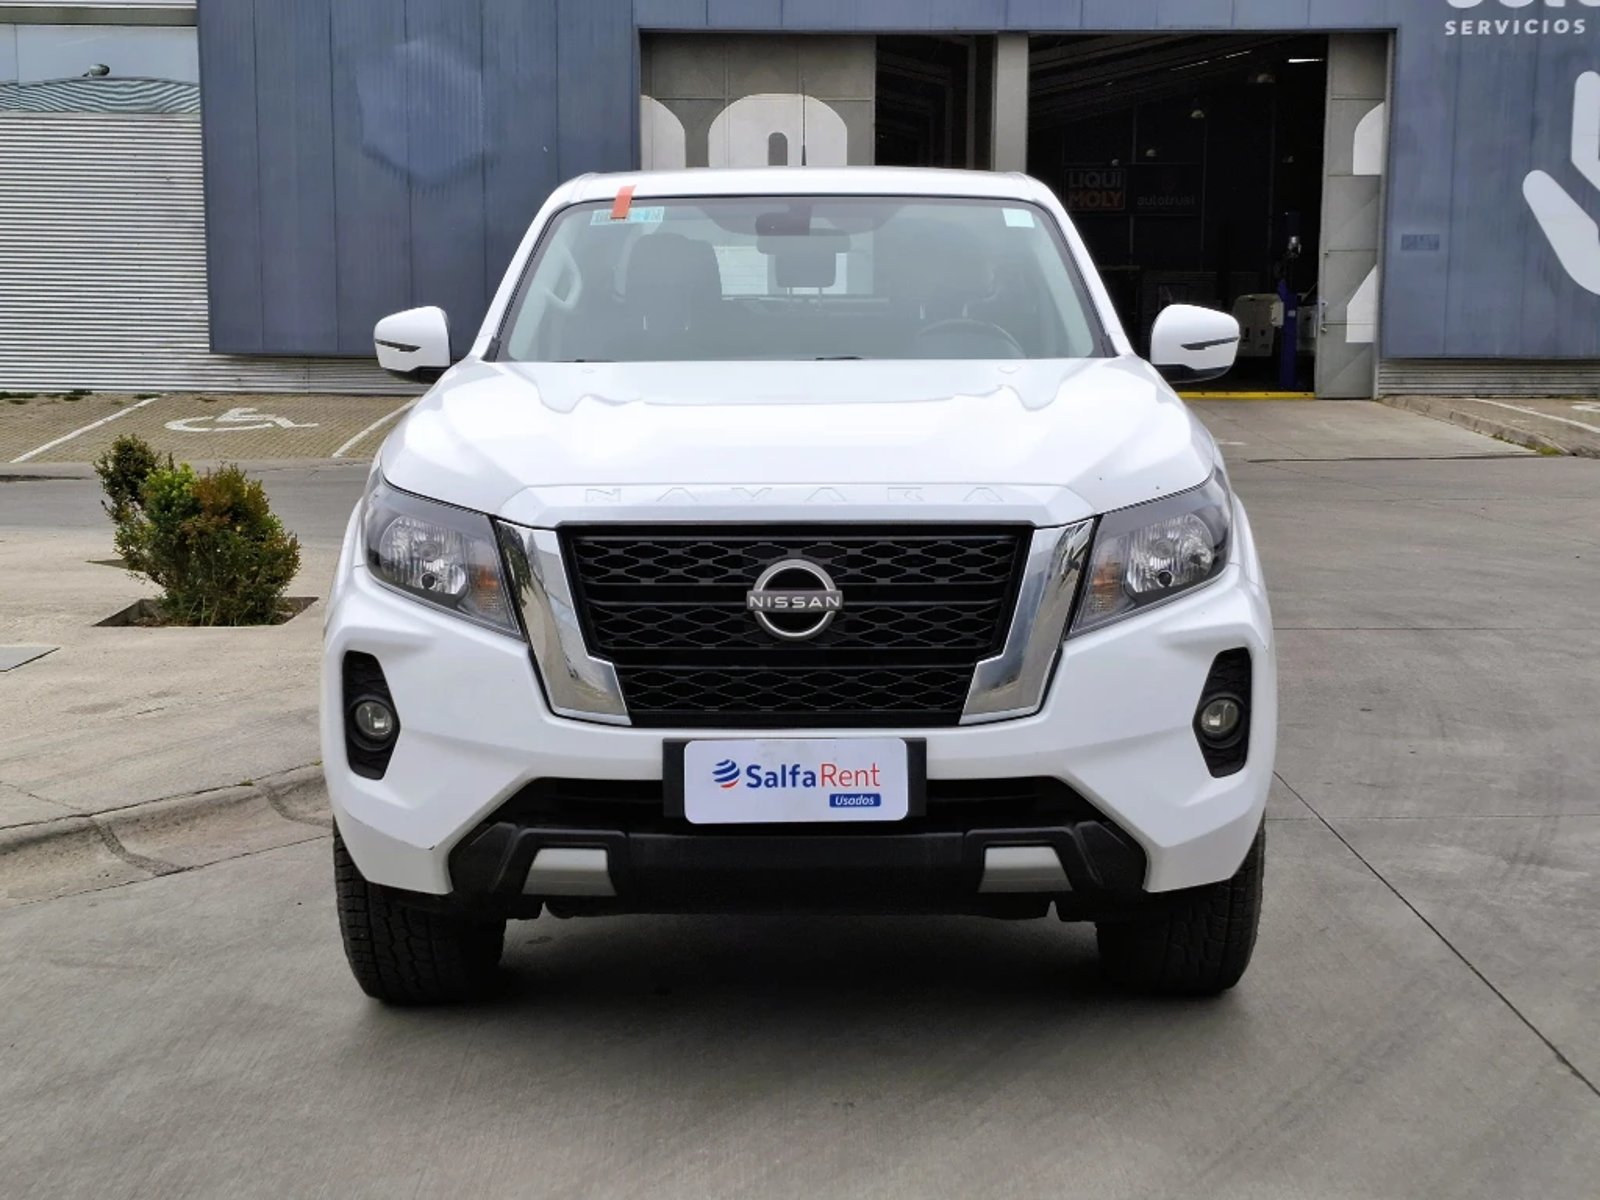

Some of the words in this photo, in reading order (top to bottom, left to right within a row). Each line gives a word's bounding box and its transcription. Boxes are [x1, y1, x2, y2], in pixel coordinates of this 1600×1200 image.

[1445, 19, 1586, 35] SERVICIOS
[1068, 171, 1122, 188] LIQUI
[1067, 191, 1122, 207] MOLY
[585, 487, 1004, 502] NAVARA
[748, 594, 841, 609] NISSAN
[746, 763, 881, 788] SalfaRent
[835, 795, 875, 806] Usados
